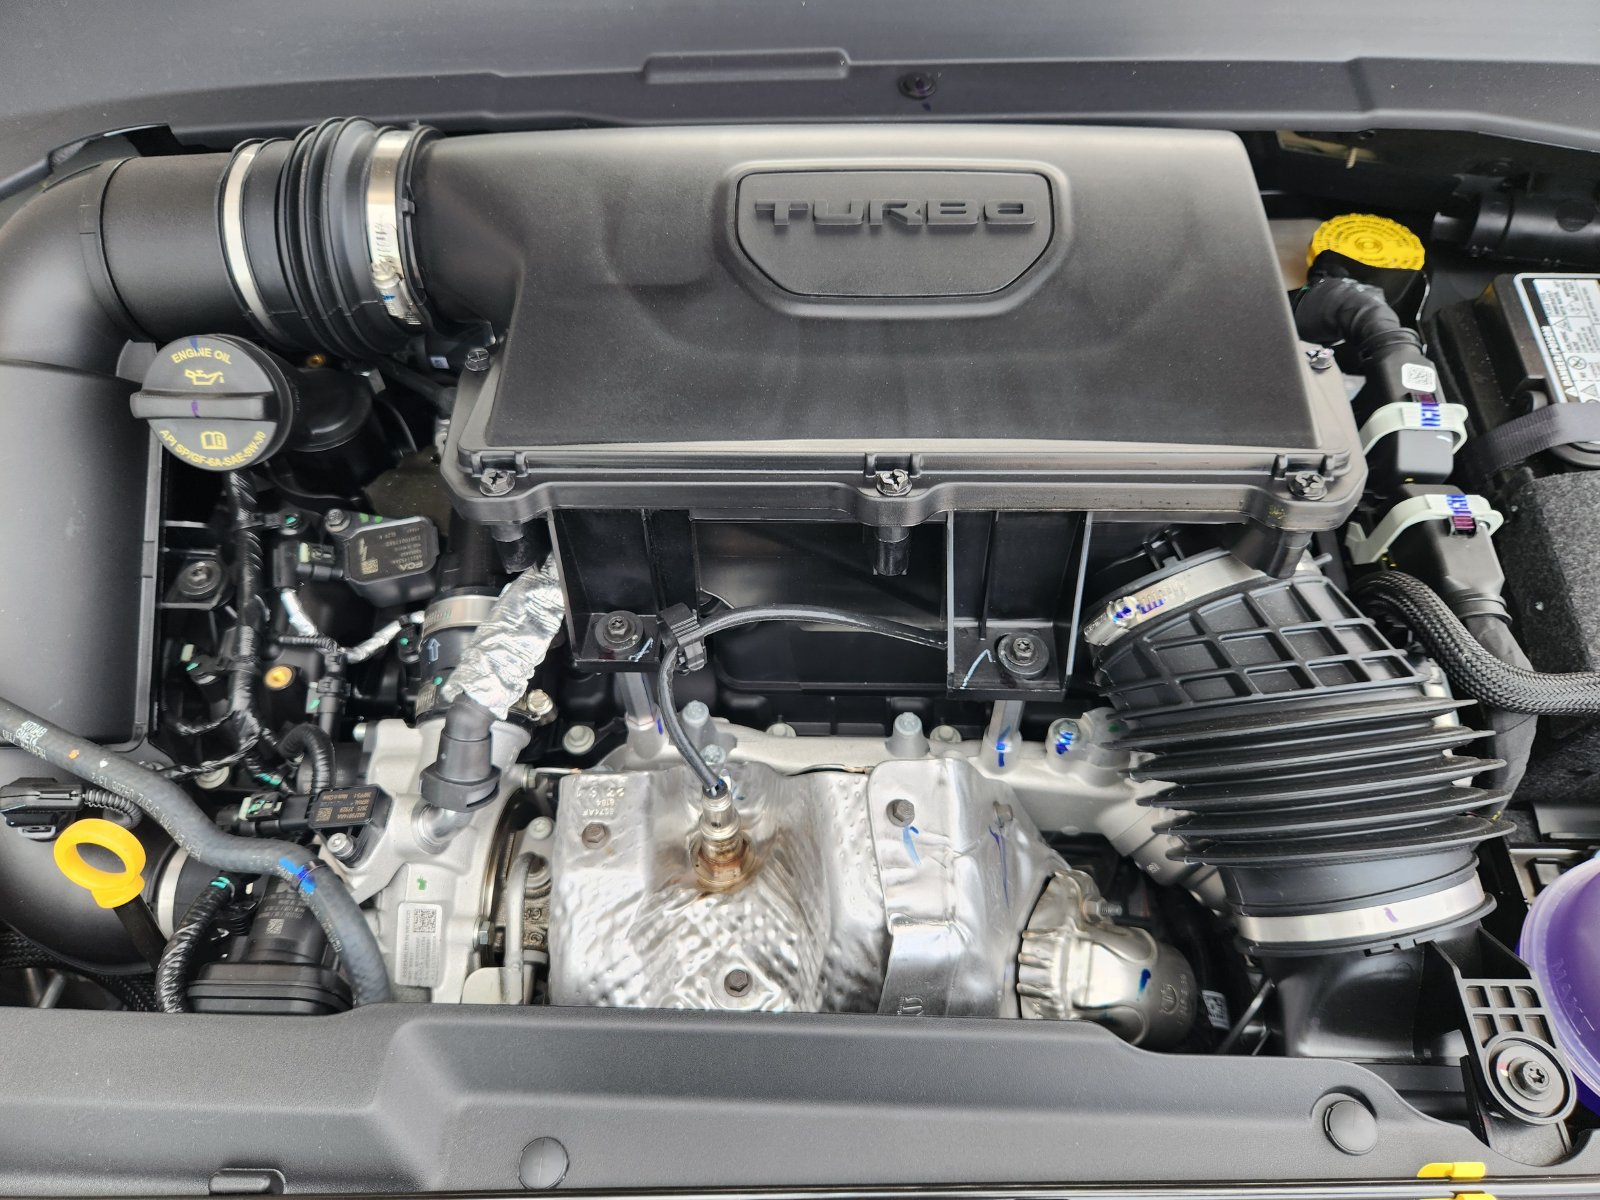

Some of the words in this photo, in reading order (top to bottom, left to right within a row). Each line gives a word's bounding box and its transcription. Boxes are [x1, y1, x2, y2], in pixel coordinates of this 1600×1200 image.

[755, 199, 1037, 226] TURBO
[171, 347, 213, 364] ENGINE
[213, 350, 232, 365] OIL
[160, 430, 178, 447] API
